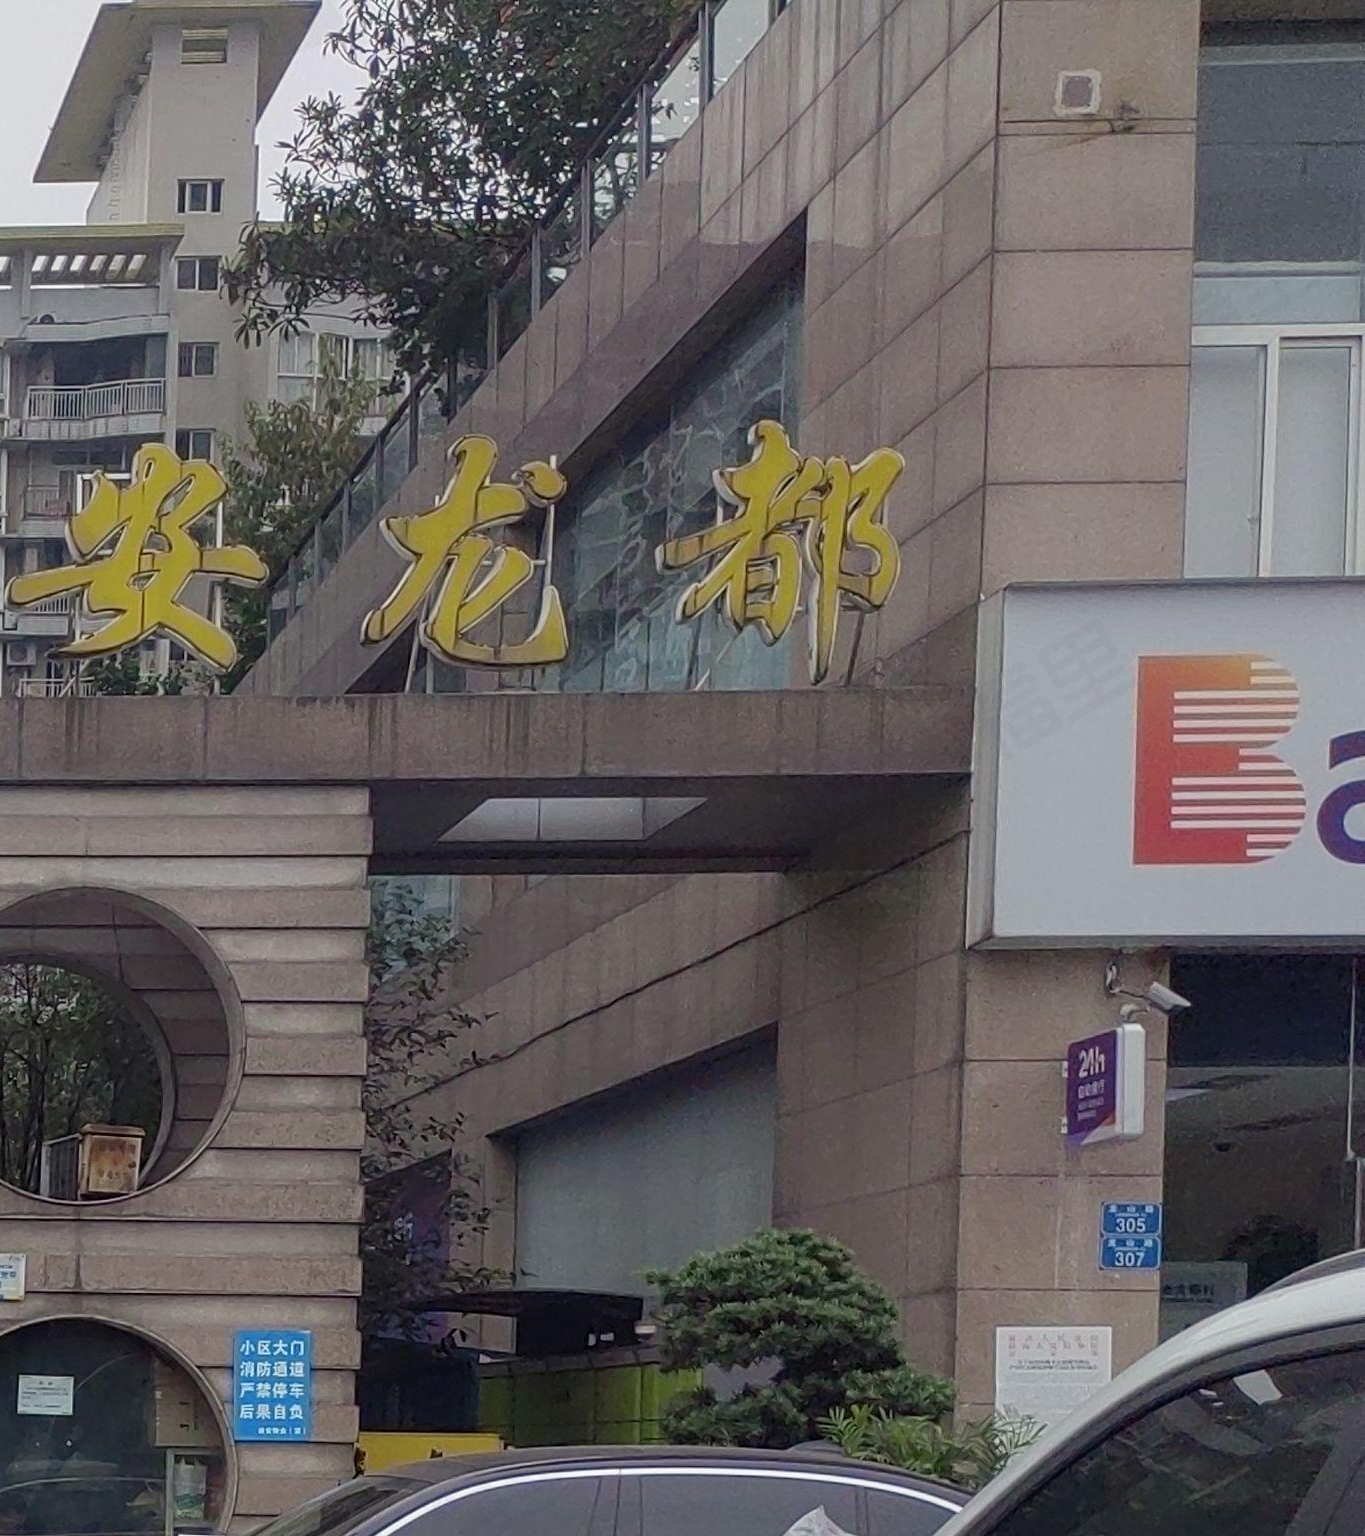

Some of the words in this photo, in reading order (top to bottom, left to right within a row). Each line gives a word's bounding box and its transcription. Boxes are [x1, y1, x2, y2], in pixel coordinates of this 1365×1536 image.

[1115, 1217, 1146, 1232] 305
[1115, 1251, 1145, 1267] 307
[240, 1339, 305, 1356] 小区大门
[240, 1361, 305, 1377] 消防通道
[240, 1382, 305, 1399] 严禁停车
[240, 1403, 304, 1420] 后果自负
